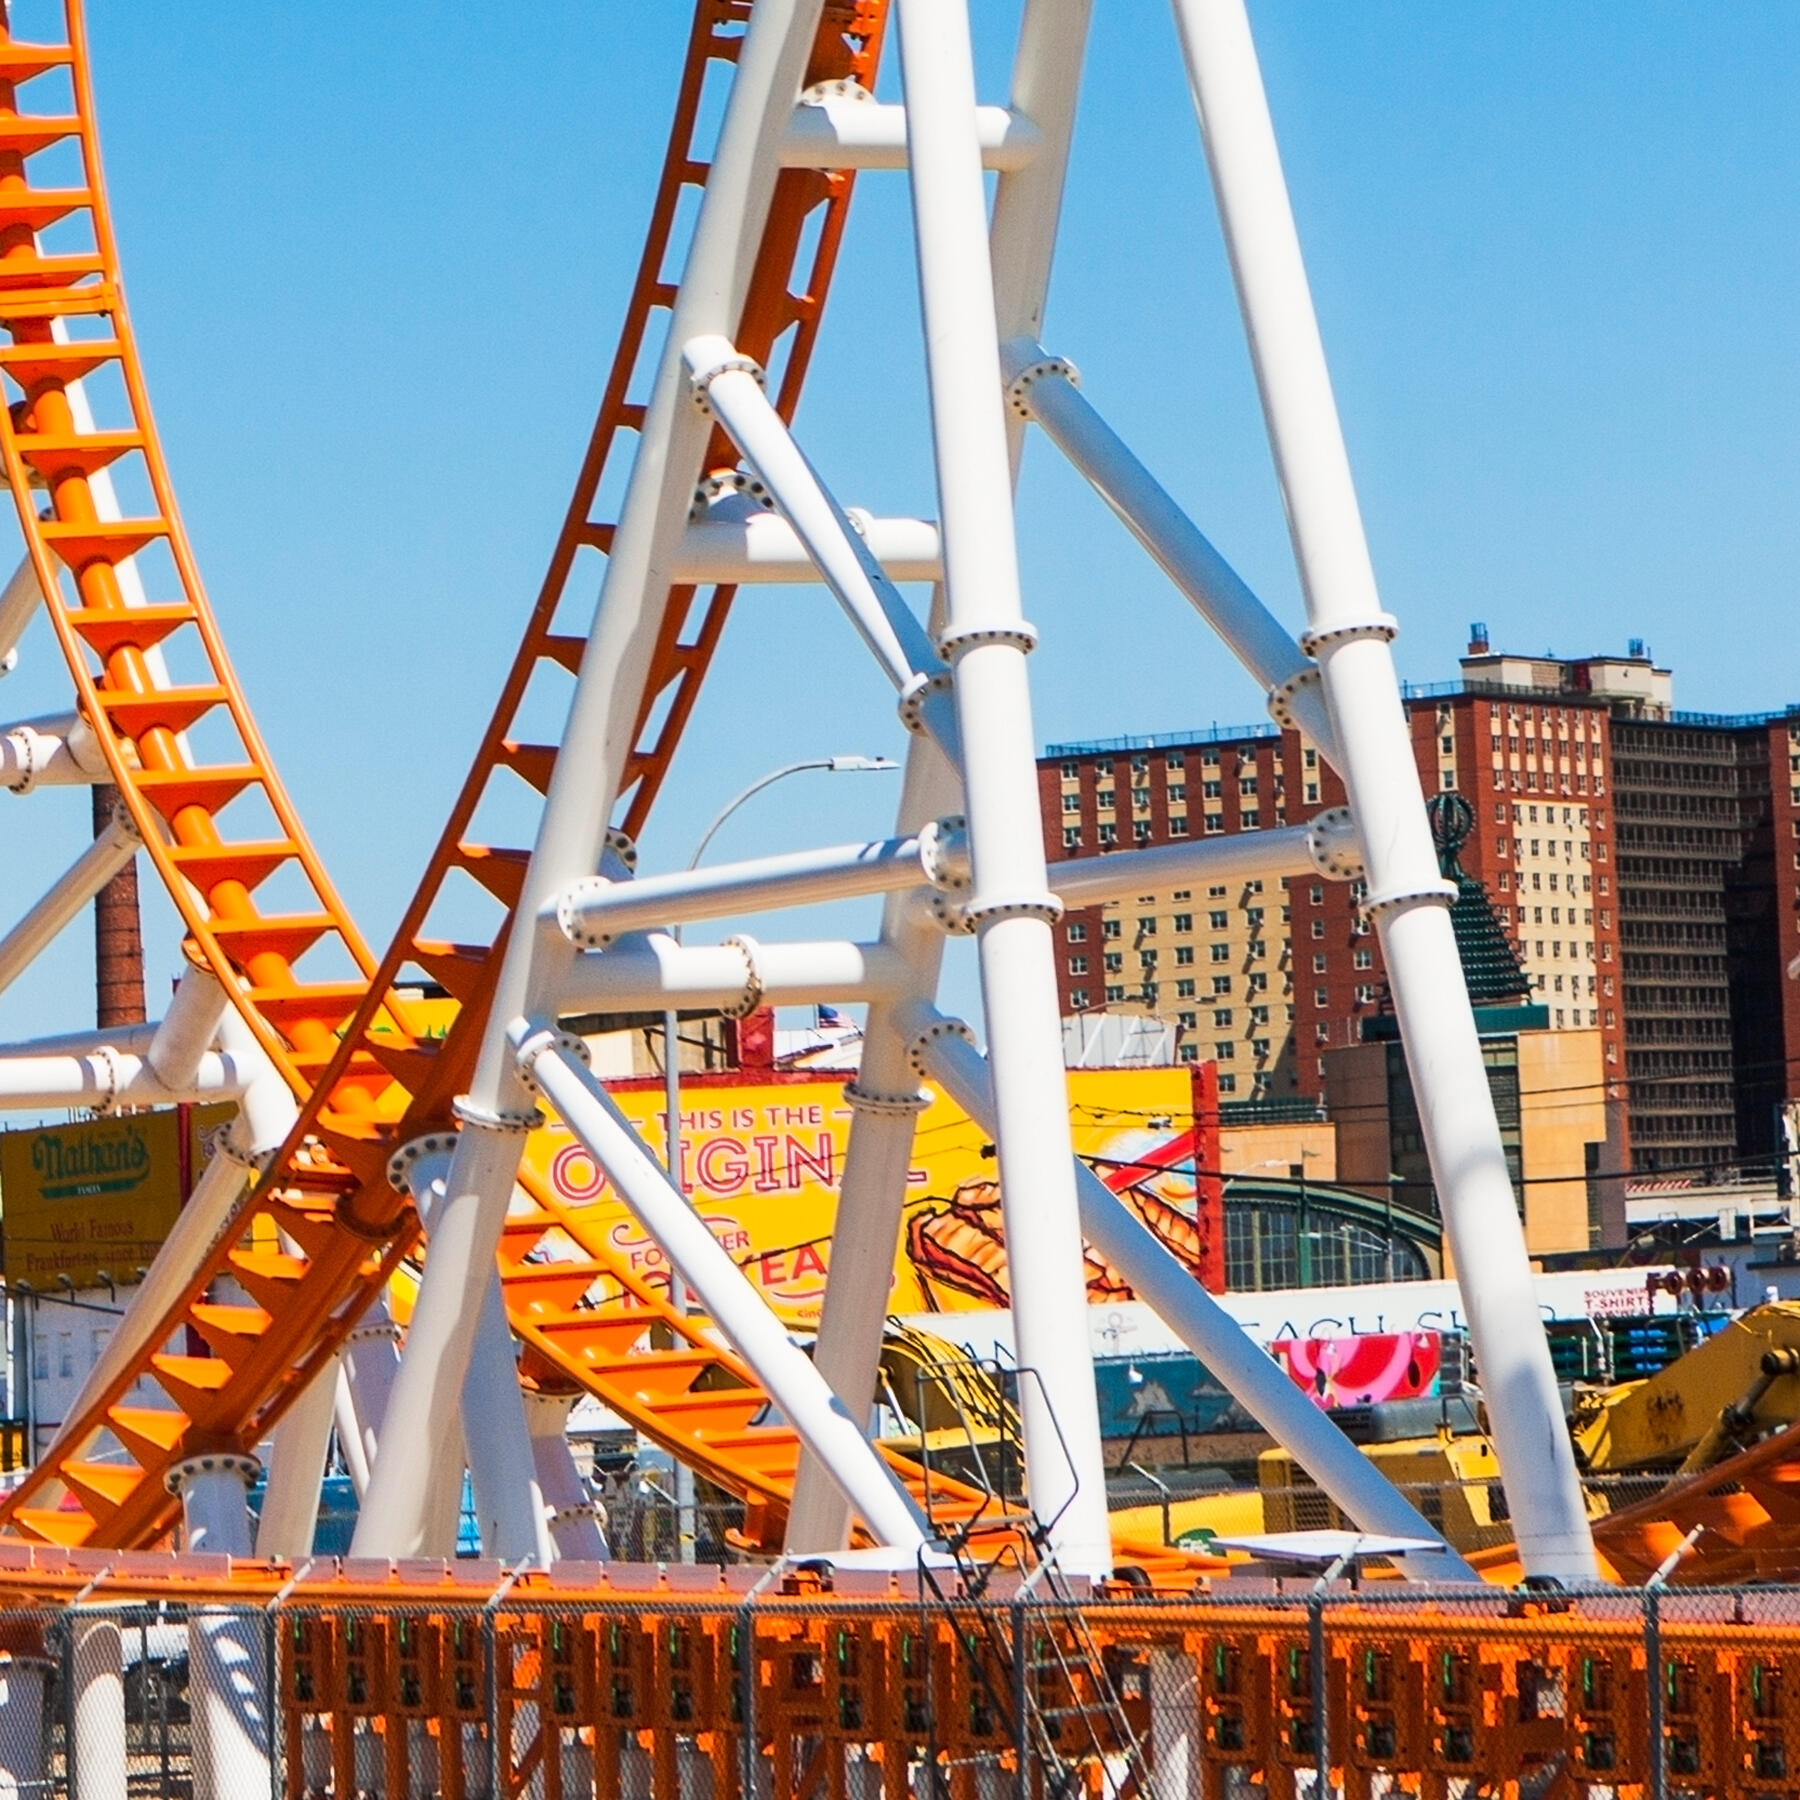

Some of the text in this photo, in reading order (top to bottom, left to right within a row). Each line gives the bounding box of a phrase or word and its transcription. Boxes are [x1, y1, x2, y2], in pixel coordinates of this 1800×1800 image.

[732, 1109, 754, 1129] IS
[766, 1105, 822, 1127] THE
[31, 1122, 149, 1182] Nathan's
[552, 1132, 928, 1201] OIGIN
[630, 1248, 664, 1271] FO
